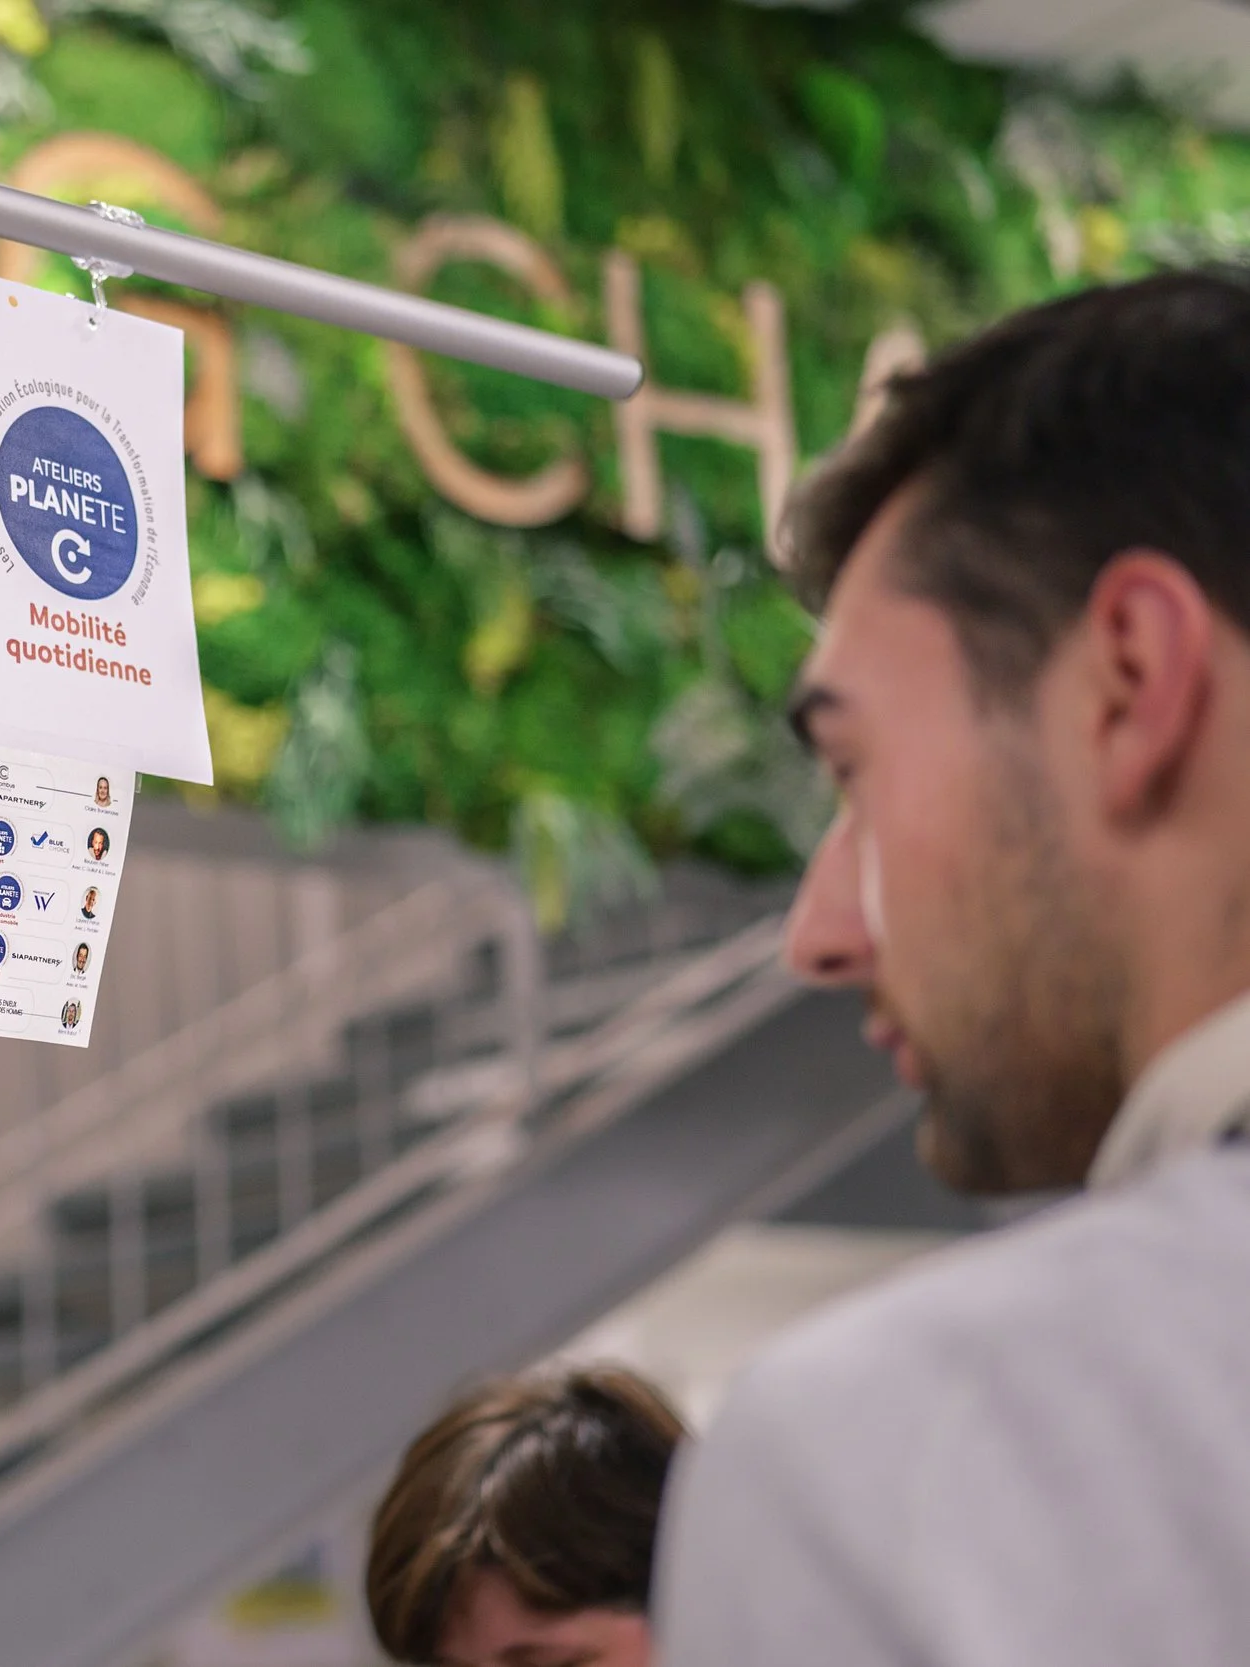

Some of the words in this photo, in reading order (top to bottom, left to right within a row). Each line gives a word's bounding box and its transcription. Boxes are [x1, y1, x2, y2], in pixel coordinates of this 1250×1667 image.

[14, 378, 73, 402] Écologique
[76, 390, 100, 413] pour
[101, 406, 112, 425] la
[111, 418, 155, 524] Transformation
[147, 526, 159, 545] de
[32, 457, 102, 493] ATELIERS
[10, 474, 127, 534] PLANETE
[29, 602, 127, 647] Mobilité
[6, 638, 152, 686] quotidienne
[49, 839, 64, 847] BLUE
